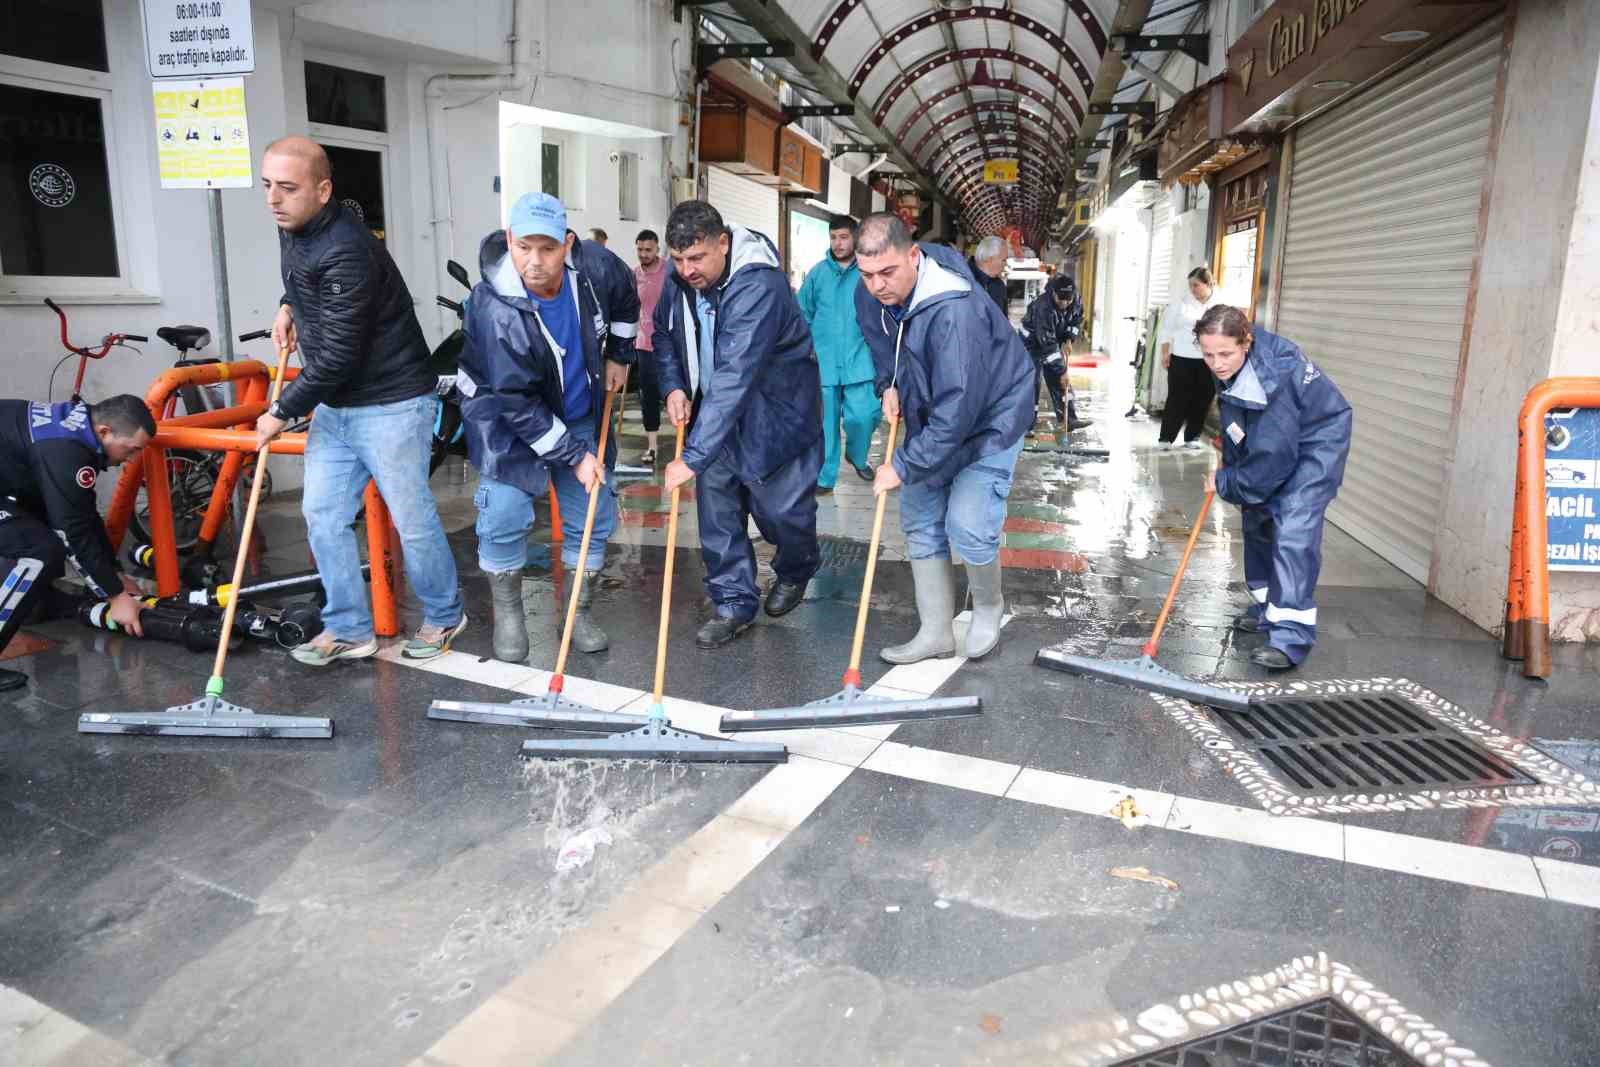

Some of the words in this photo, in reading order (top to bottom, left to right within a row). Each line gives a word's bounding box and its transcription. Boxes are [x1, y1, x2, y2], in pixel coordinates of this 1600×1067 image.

[176, 1, 221, 19] 06:00-11:00
[170, 27, 199, 42] saatleri
[200, 24, 230, 44] dışında
[1266, 14, 1305, 77] Can
[159, 54, 176, 68] araç
[177, 49, 210, 68] trafiğine
[211, 46, 248, 65] kapalıdır.
[1546, 494, 1595, 517] ACİL
[1583, 542, 1600, 563] İŞ
